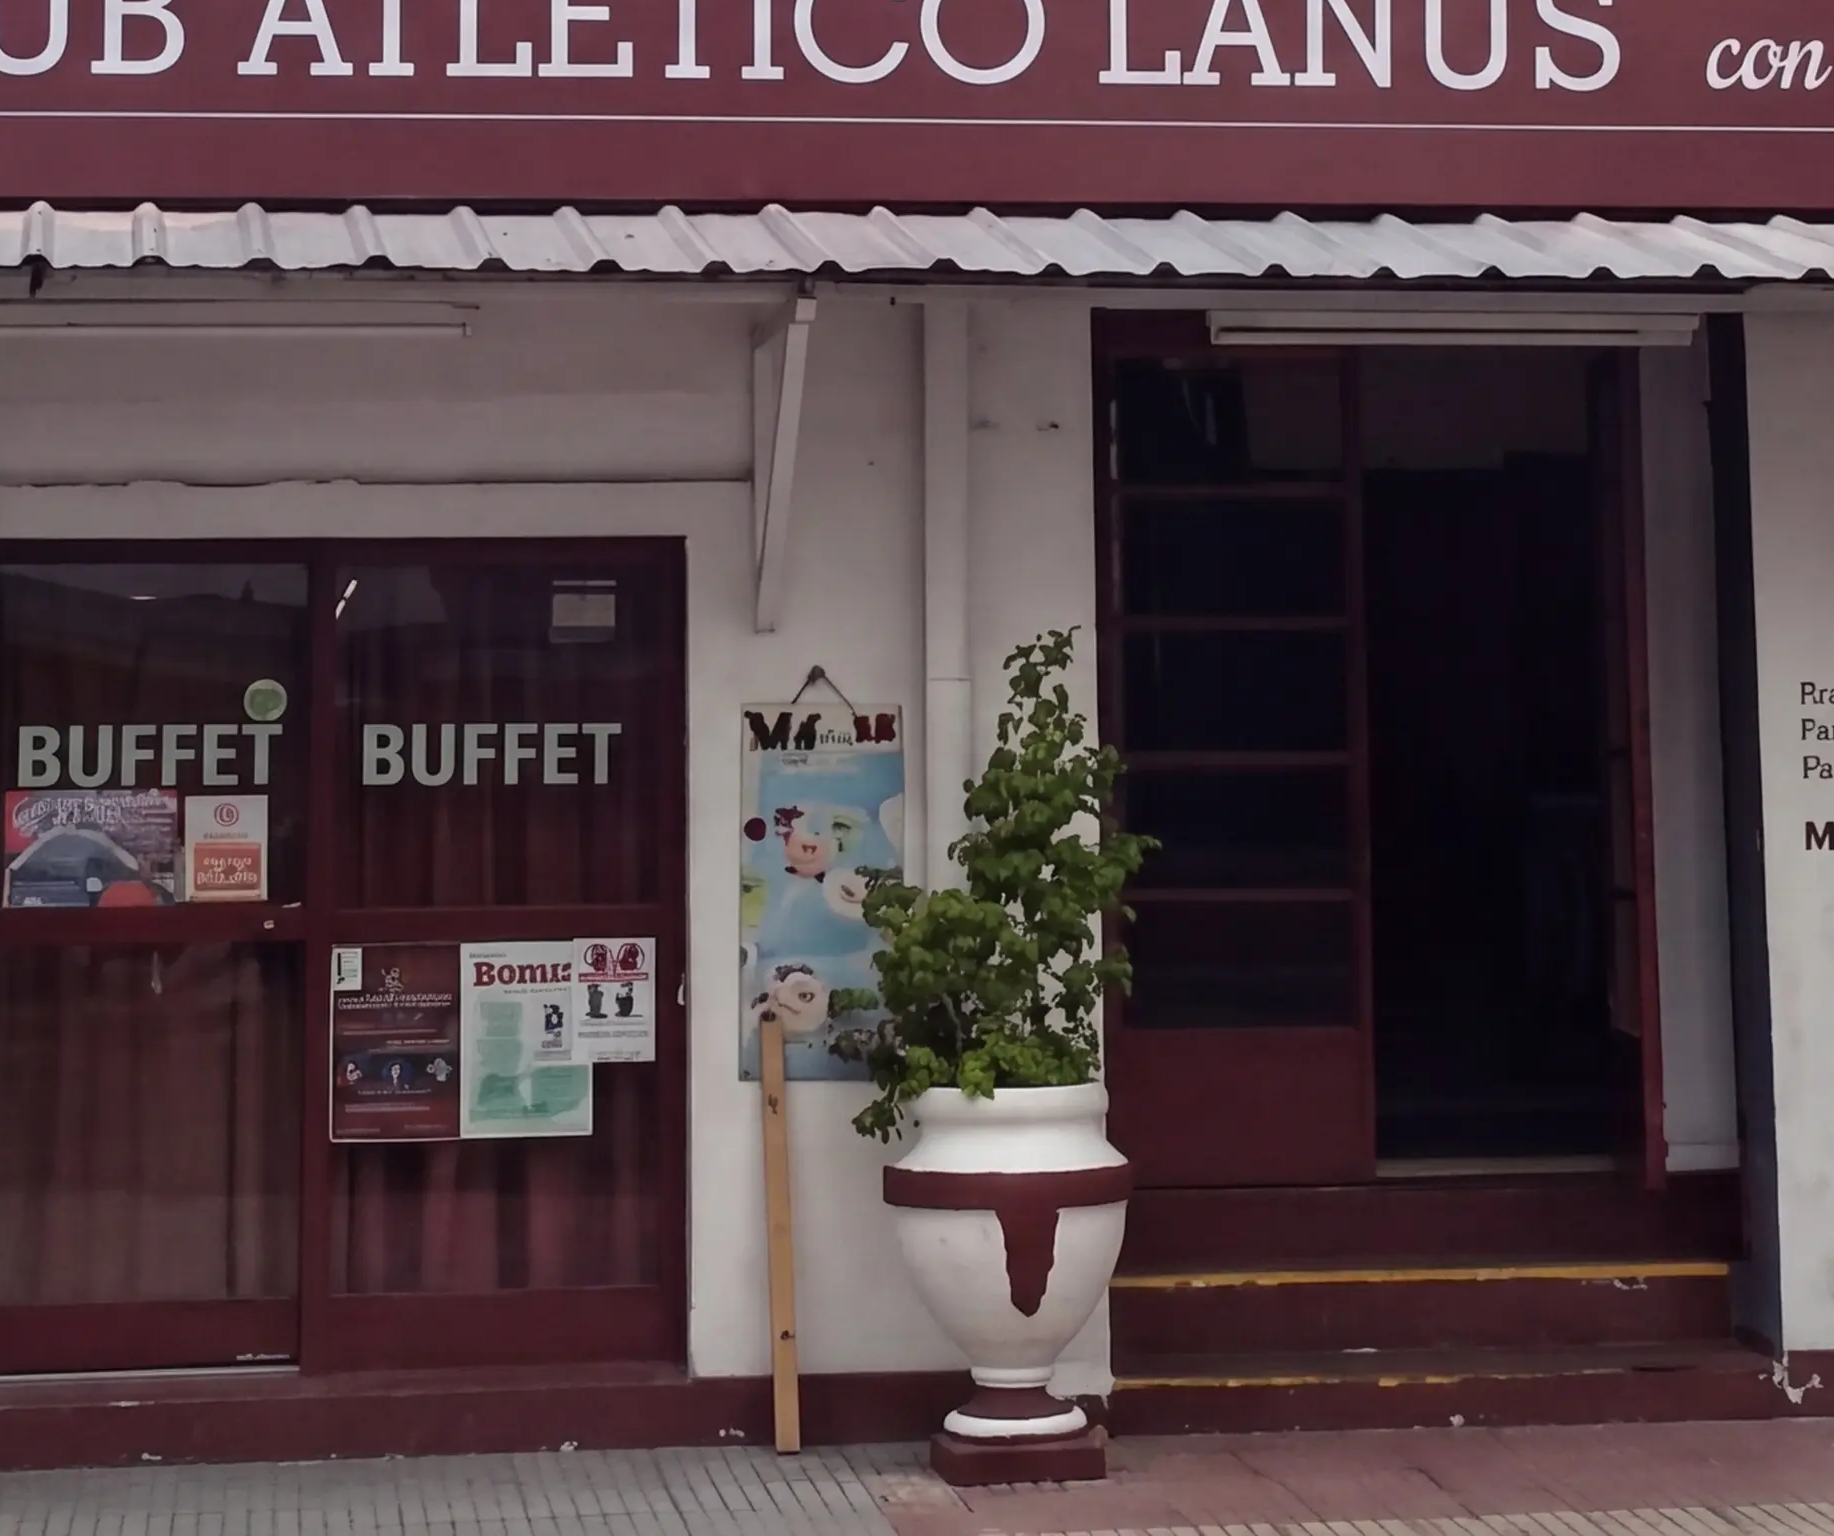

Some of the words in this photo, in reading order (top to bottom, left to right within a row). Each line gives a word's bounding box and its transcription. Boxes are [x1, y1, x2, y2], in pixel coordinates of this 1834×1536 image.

[1706, 38, 1833, 90] con
[17, 723, 283, 788] BUFFET
[362, 722, 622, 787] BUFFET
